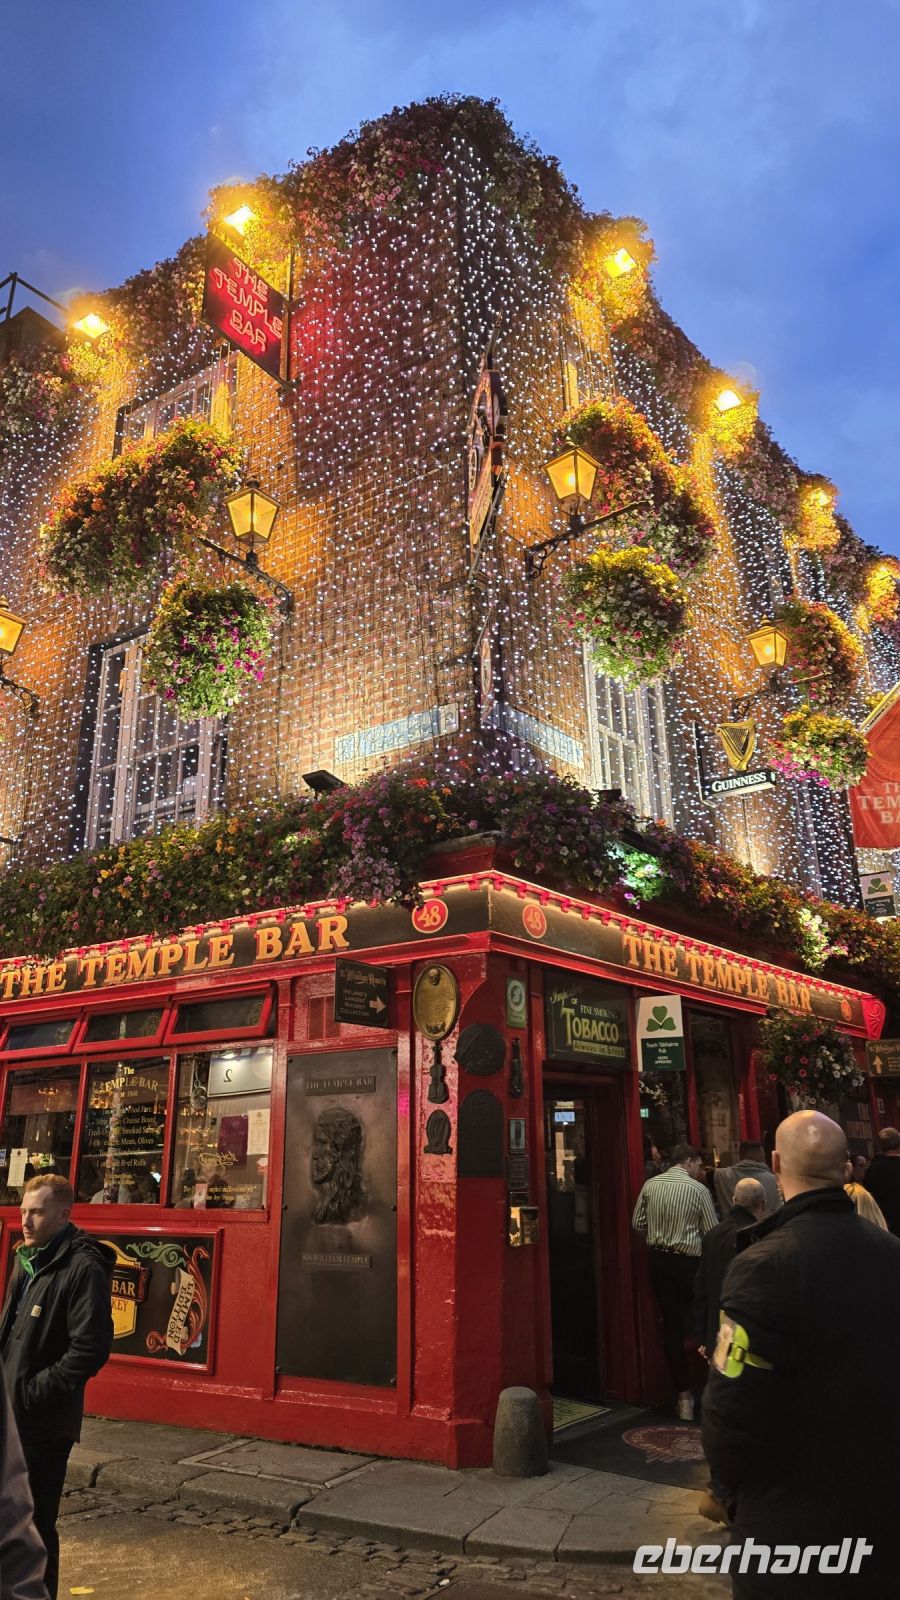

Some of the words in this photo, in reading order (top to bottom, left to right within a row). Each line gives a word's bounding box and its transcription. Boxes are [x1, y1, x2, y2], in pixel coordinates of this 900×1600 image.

[233, 257, 268, 302] THE
[213, 267, 282, 339] TEMPLE
[230, 309, 267, 352] BAR
[711, 771, 767, 792] GUINNESS
[417, 904, 442, 928] 48
[527, 909, 542, 930] 48
[0, 963, 67, 999] THE
[78, 934, 236, 987] TEMPLE
[255, 915, 350, 960] BAR
[623, 934, 679, 977] THE
[685, 952, 770, 1001] TEMPLE
[776, 980, 812, 1012] BAR
[560, 1007, 619, 1046] TOBACCO
[124, 1067, 135, 1075] The
[141, 1078, 158, 1092] BAR
[323, 1079, 355, 1089] TEMPLE
[356, 1077, 374, 1087] BAR
[112, 1280, 136, 1297] BAR
[168, 1286, 187, 1339] EDITION
[173, 1281, 195, 1344] LIMITED
